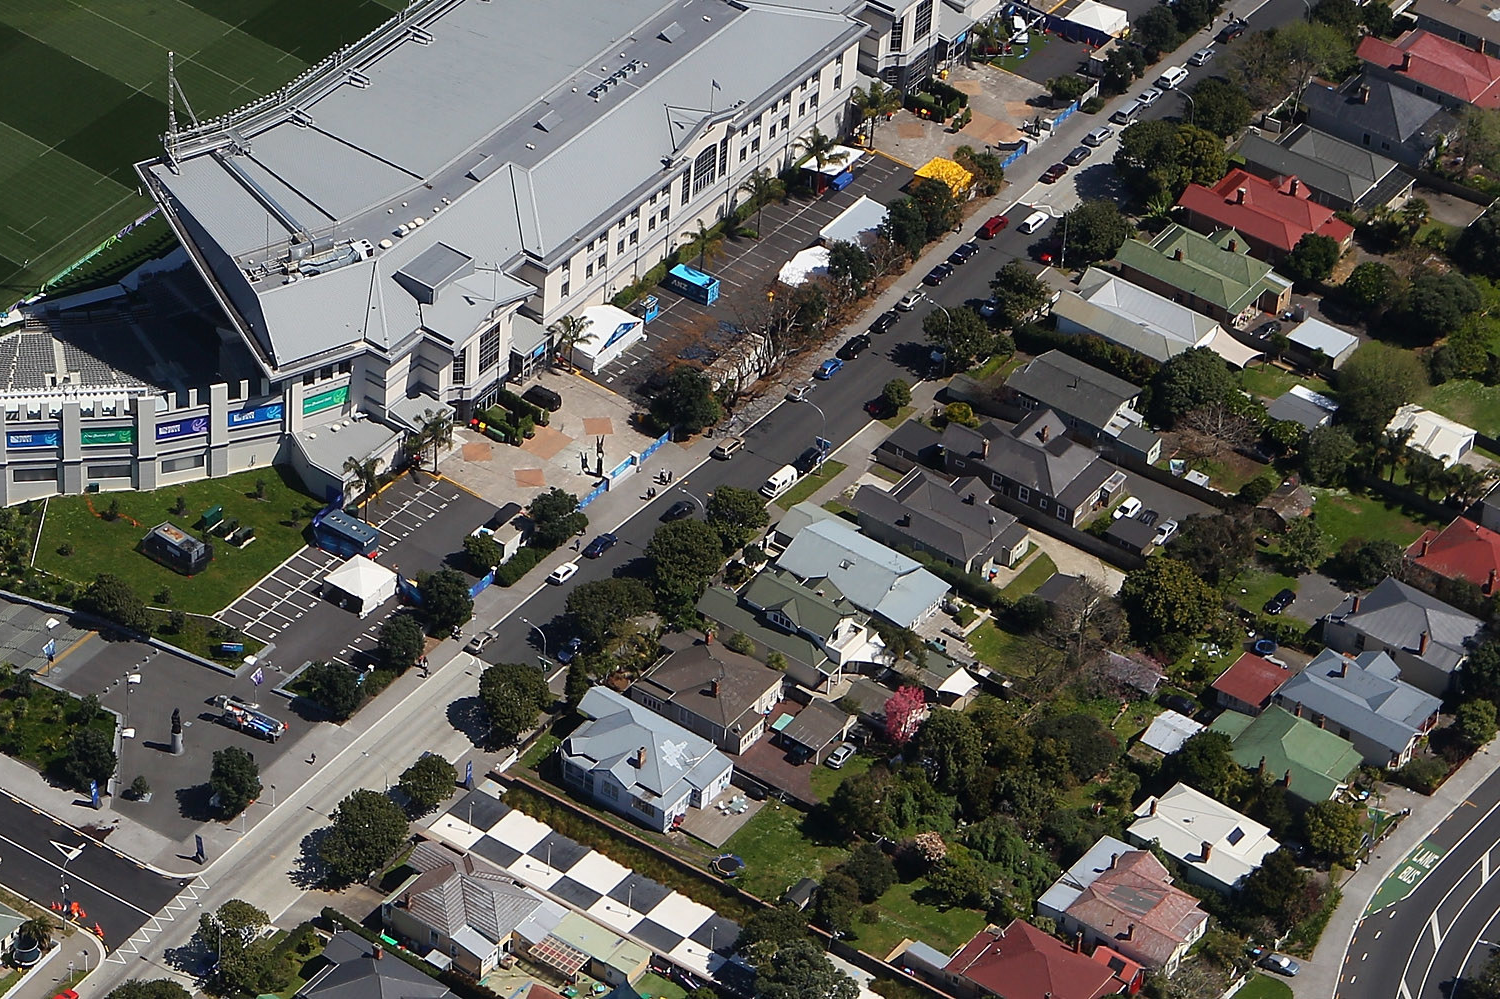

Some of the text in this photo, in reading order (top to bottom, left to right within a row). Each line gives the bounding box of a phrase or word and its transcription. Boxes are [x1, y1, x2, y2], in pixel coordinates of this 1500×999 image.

[671, 280, 688, 290] ANZ
[1412, 847, 1440, 869] LANE
[1397, 865, 1422, 885] BUS
